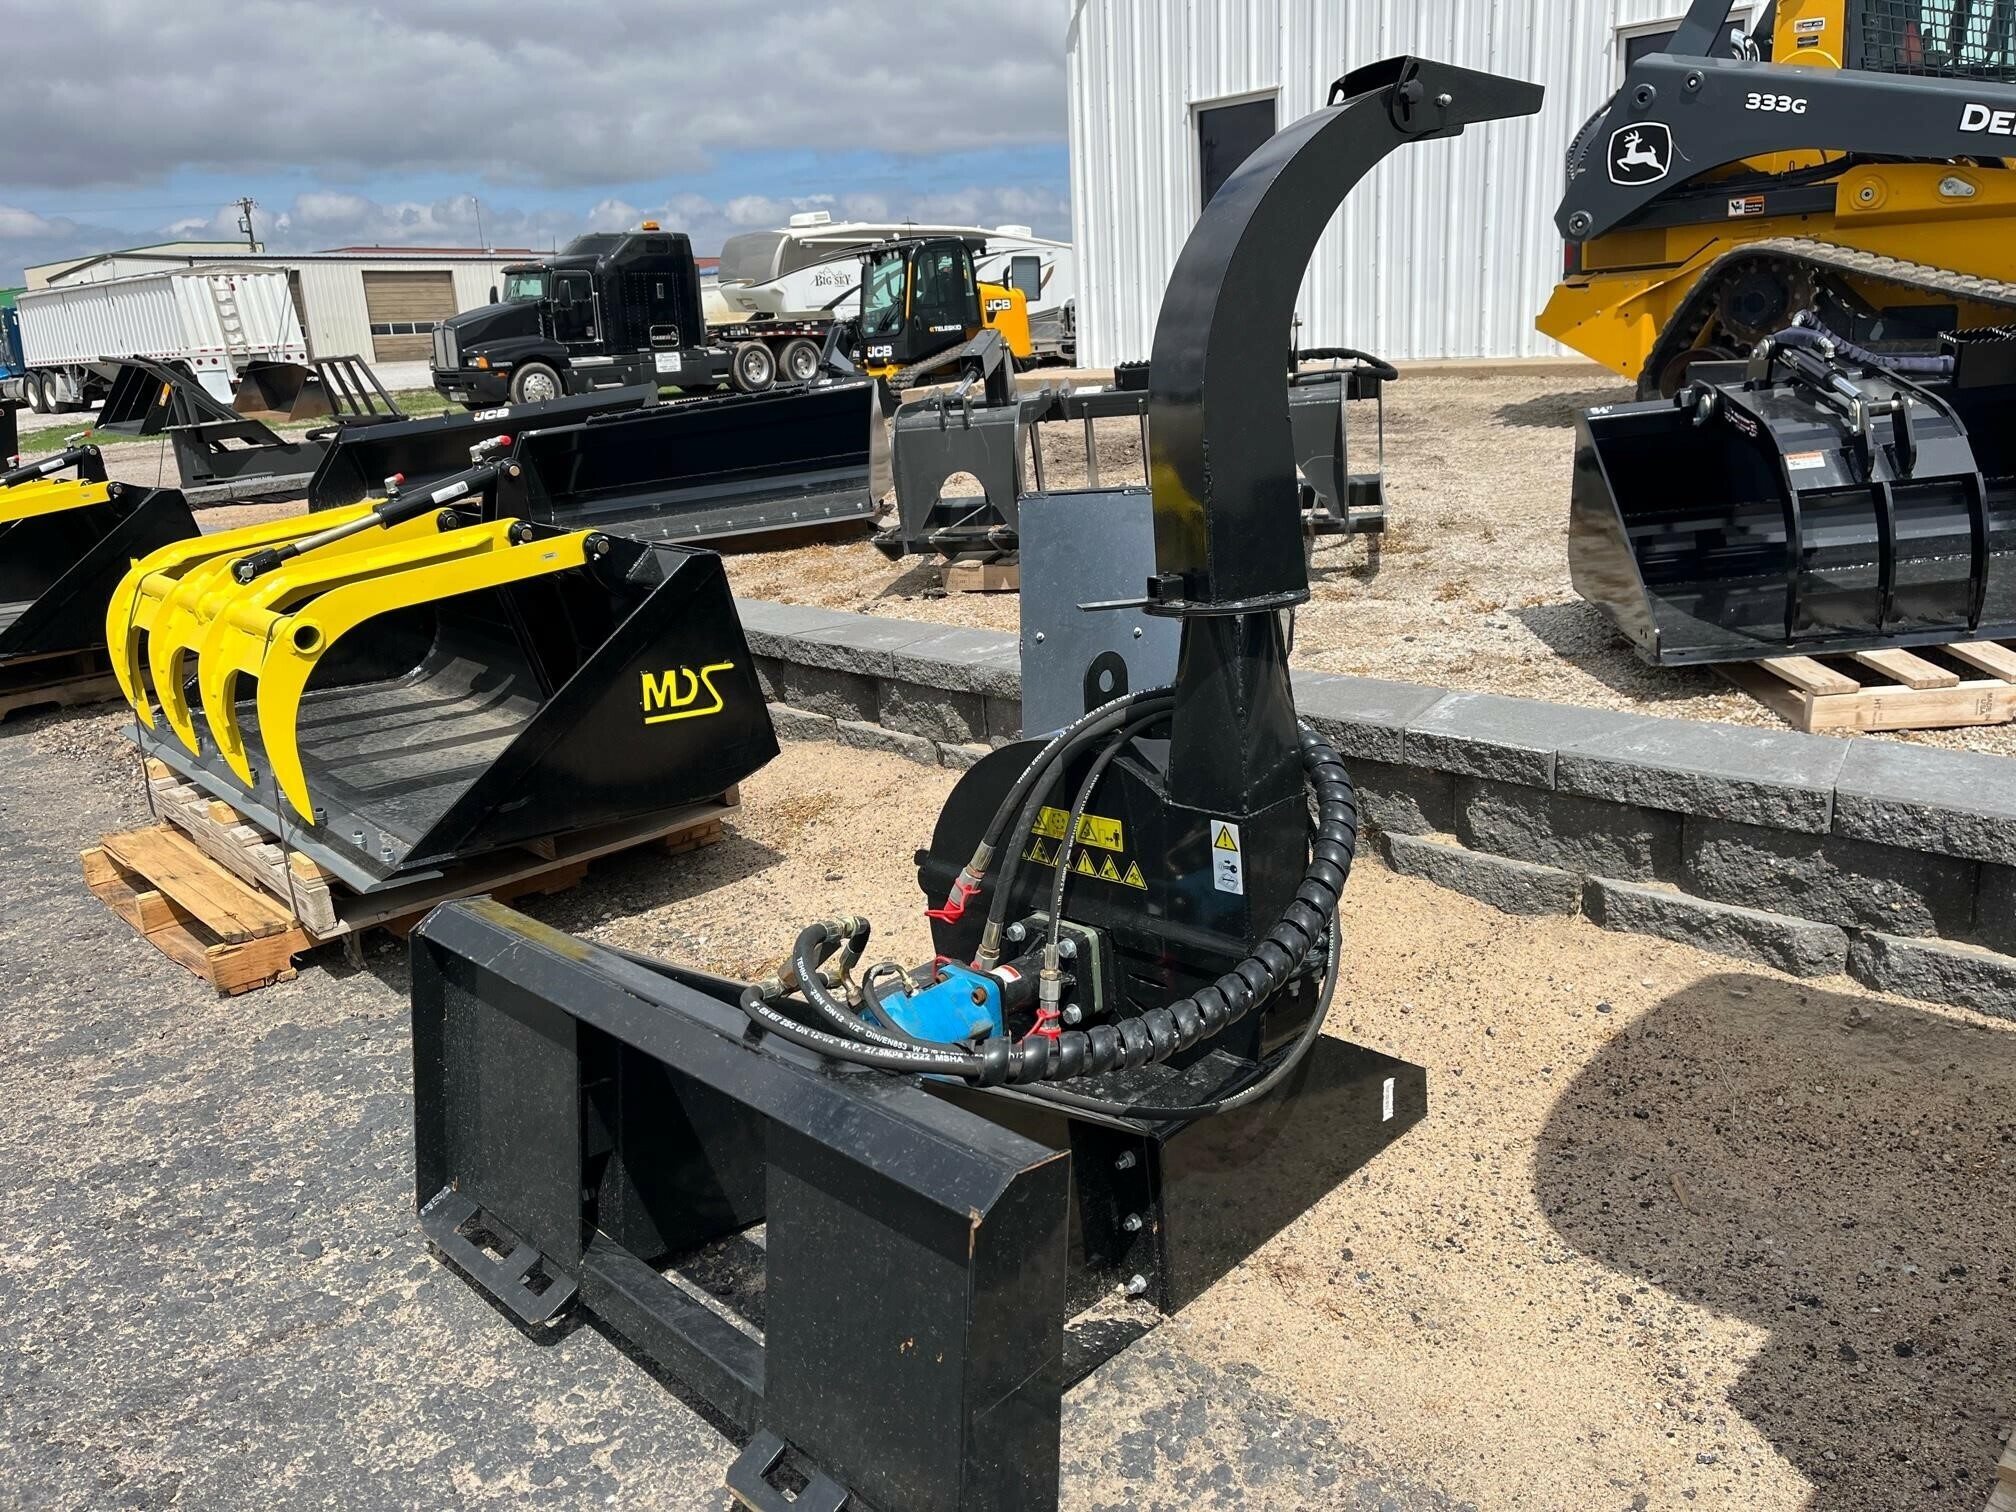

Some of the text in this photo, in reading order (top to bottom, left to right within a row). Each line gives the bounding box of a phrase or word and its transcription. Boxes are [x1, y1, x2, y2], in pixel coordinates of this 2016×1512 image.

[1745, 93, 1807, 113] 333G
[1959, 103, 2016, 135] DE
[815, 275, 832, 286] BIG
[985, 299, 1011, 311] JCB
[867, 345, 893, 358] JCB
[473, 408, 510, 422] JCB
[642, 662, 735, 725] MDS
[796, 957, 809, 981] TEHNO
[824, 1004, 845, 1022] DN12
[865, 1026, 908, 1050] DIN/EN853
[795, 1025, 810, 1036] DN
[905, 1051, 931, 1061] 3Q22
[935, 1054, 964, 1063] MSHA
